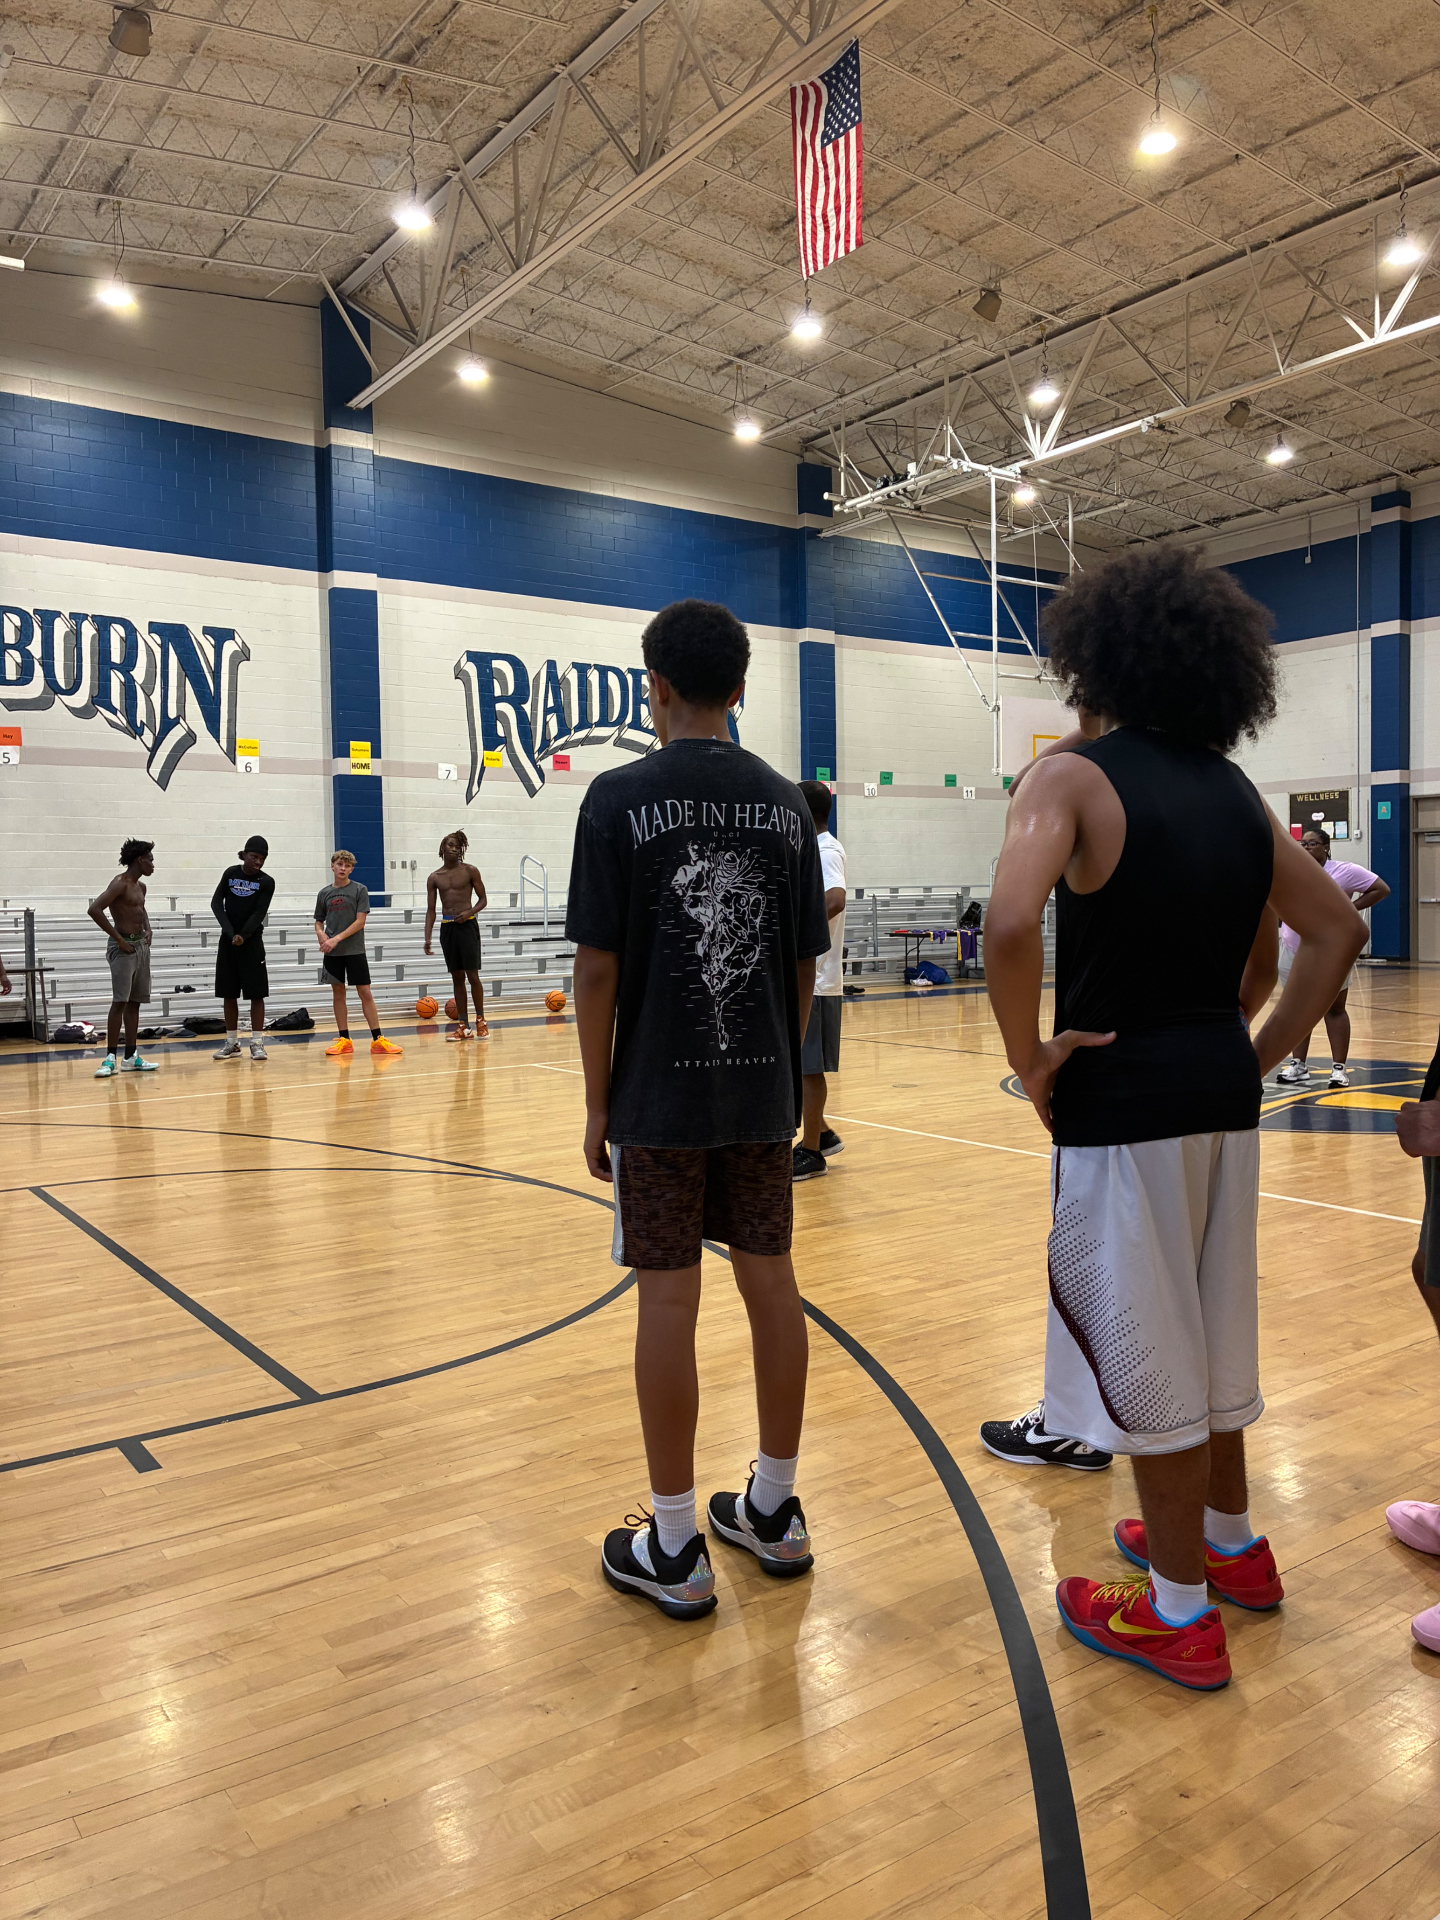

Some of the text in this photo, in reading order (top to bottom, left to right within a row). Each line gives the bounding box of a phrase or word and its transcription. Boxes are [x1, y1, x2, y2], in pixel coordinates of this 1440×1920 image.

[2, 752, 11, 764] 5
[244, 761, 252, 773] 6
[351, 762, 371, 770] HOME
[445, 769, 451, 779] 7
[867, 787, 876, 796] 10
[965, 789, 973, 798] 11
[1297, 792, 1339, 802] WELLNESS
[627, 799, 696, 850] MADE
[702, 801, 727, 827] IN
[726, 1056, 776, 1065] HEAVEN
[1082, 1444, 1088, 1453] 2
